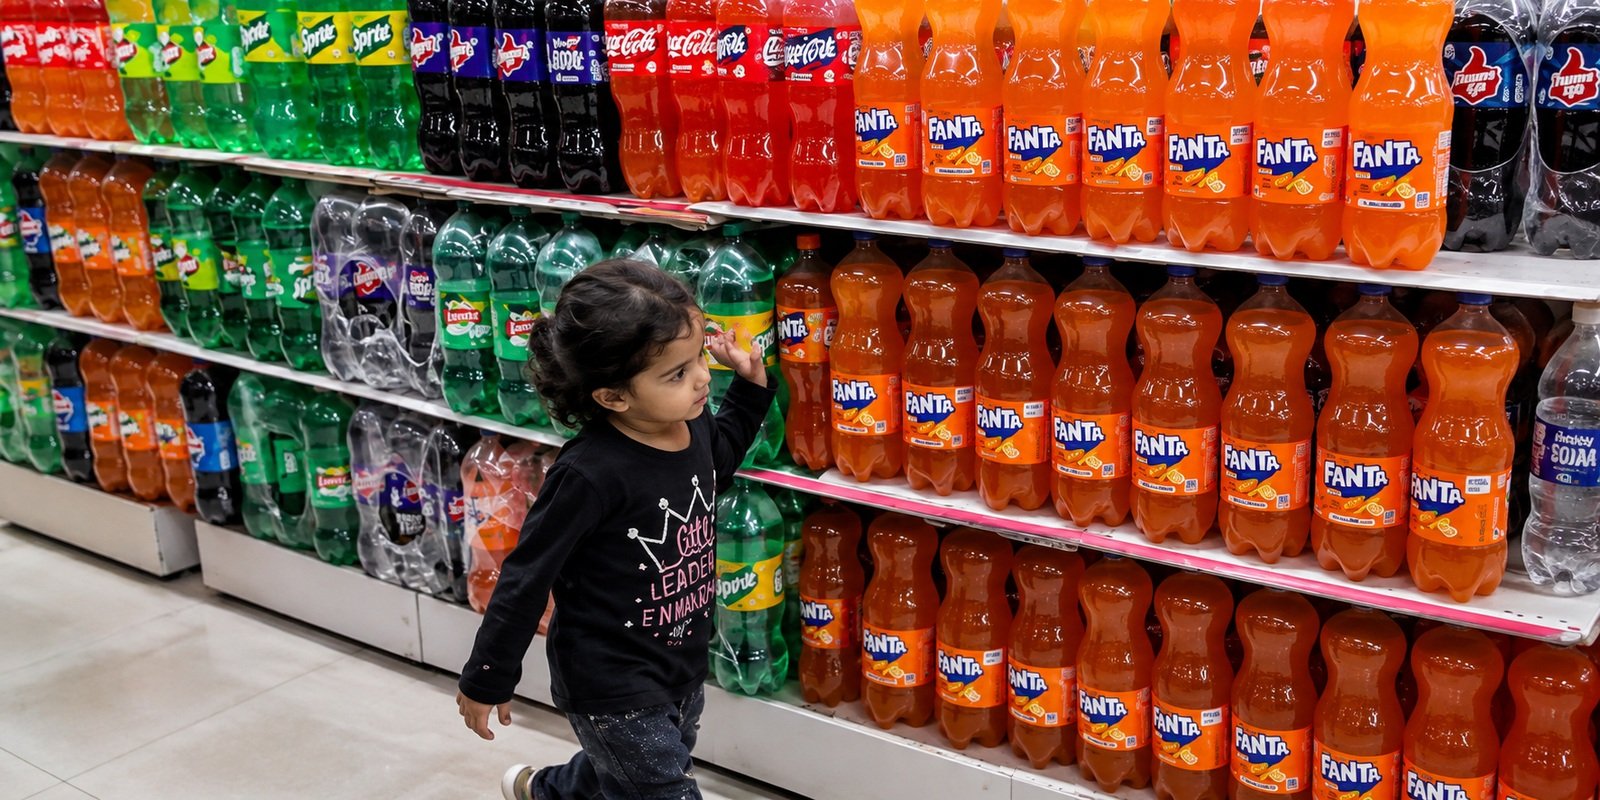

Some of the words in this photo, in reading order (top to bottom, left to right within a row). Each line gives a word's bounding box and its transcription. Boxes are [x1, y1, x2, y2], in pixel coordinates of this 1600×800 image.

[855, 109, 898, 132] FANTA
[929, 116, 984, 141] FANTA
[1008, 126, 1062, 151] FANTA
[1087, 125, 1146, 151] FANTA
[1169, 134, 1230, 161] FANTA
[1257, 138, 1317, 165] FANTA
[1353, 140, 1421, 168] FANTA
[832, 379, 877, 401] FANTA
[906, 391, 955, 414] FANTA
[977, 404, 1023, 429] FANTA
[1054, 417, 1105, 442] FANTA
[1135, 430, 1189, 456] FANTA
[1224, 445, 1280, 472] FANTA
[1324, 460, 1388, 488] FANTA
[1412, 472, 1465, 504] FANTA
[801, 602, 833, 621] ANTA
[863, 629, 907, 653] FANTA
[938, 651, 983, 676] FANTA
[1008, 664, 1047, 691] FANTA
[1079, 690, 1127, 716] FANTA
[1154, 706, 1201, 737] FANTA
[1235, 726, 1290, 756] FANTA
[1321, 752, 1382, 784] FANTA
[1407, 770, 1468, 800] FANTA
